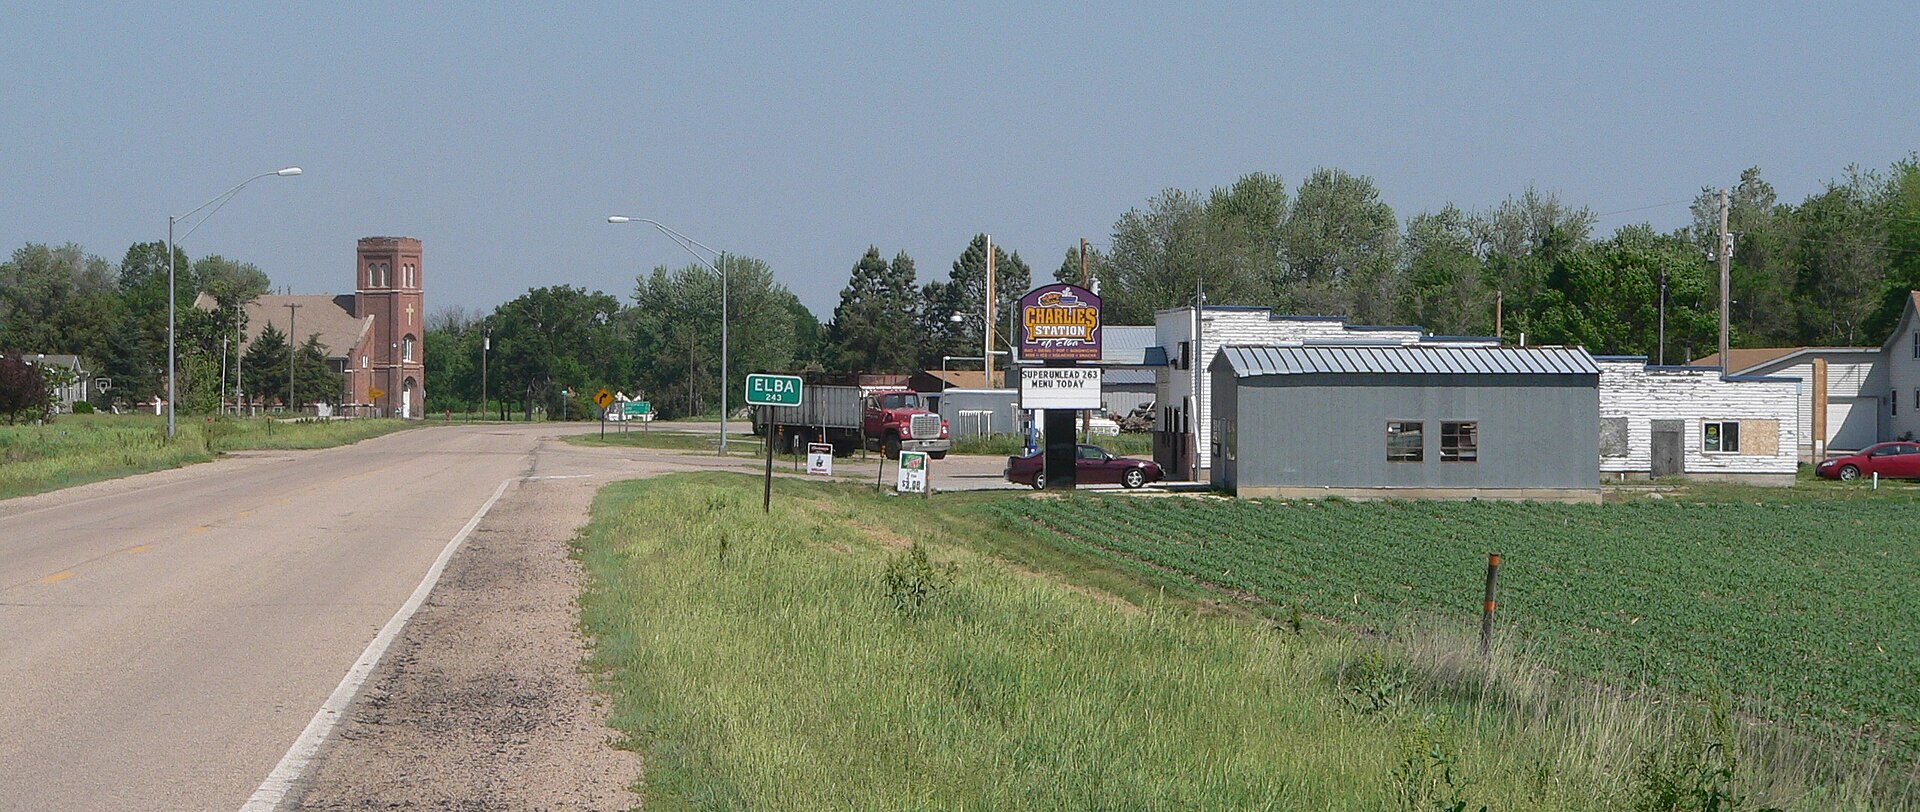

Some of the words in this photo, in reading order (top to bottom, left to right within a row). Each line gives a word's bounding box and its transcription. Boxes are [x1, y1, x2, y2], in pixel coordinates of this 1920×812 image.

[1025, 307, 1097, 328] CHARLIES
[1035, 325, 1085, 336] STATION
[1041, 339, 1052, 348] of
[1022, 370, 1080, 379] SUPERUNLEAD
[1082, 370, 1098, 379] 263
[754, 378, 794, 393] ELBA
[1031, 380, 1054, 388] MENU
[1056, 380, 1085, 388] TODAY
[765, 393, 782, 402] 243
